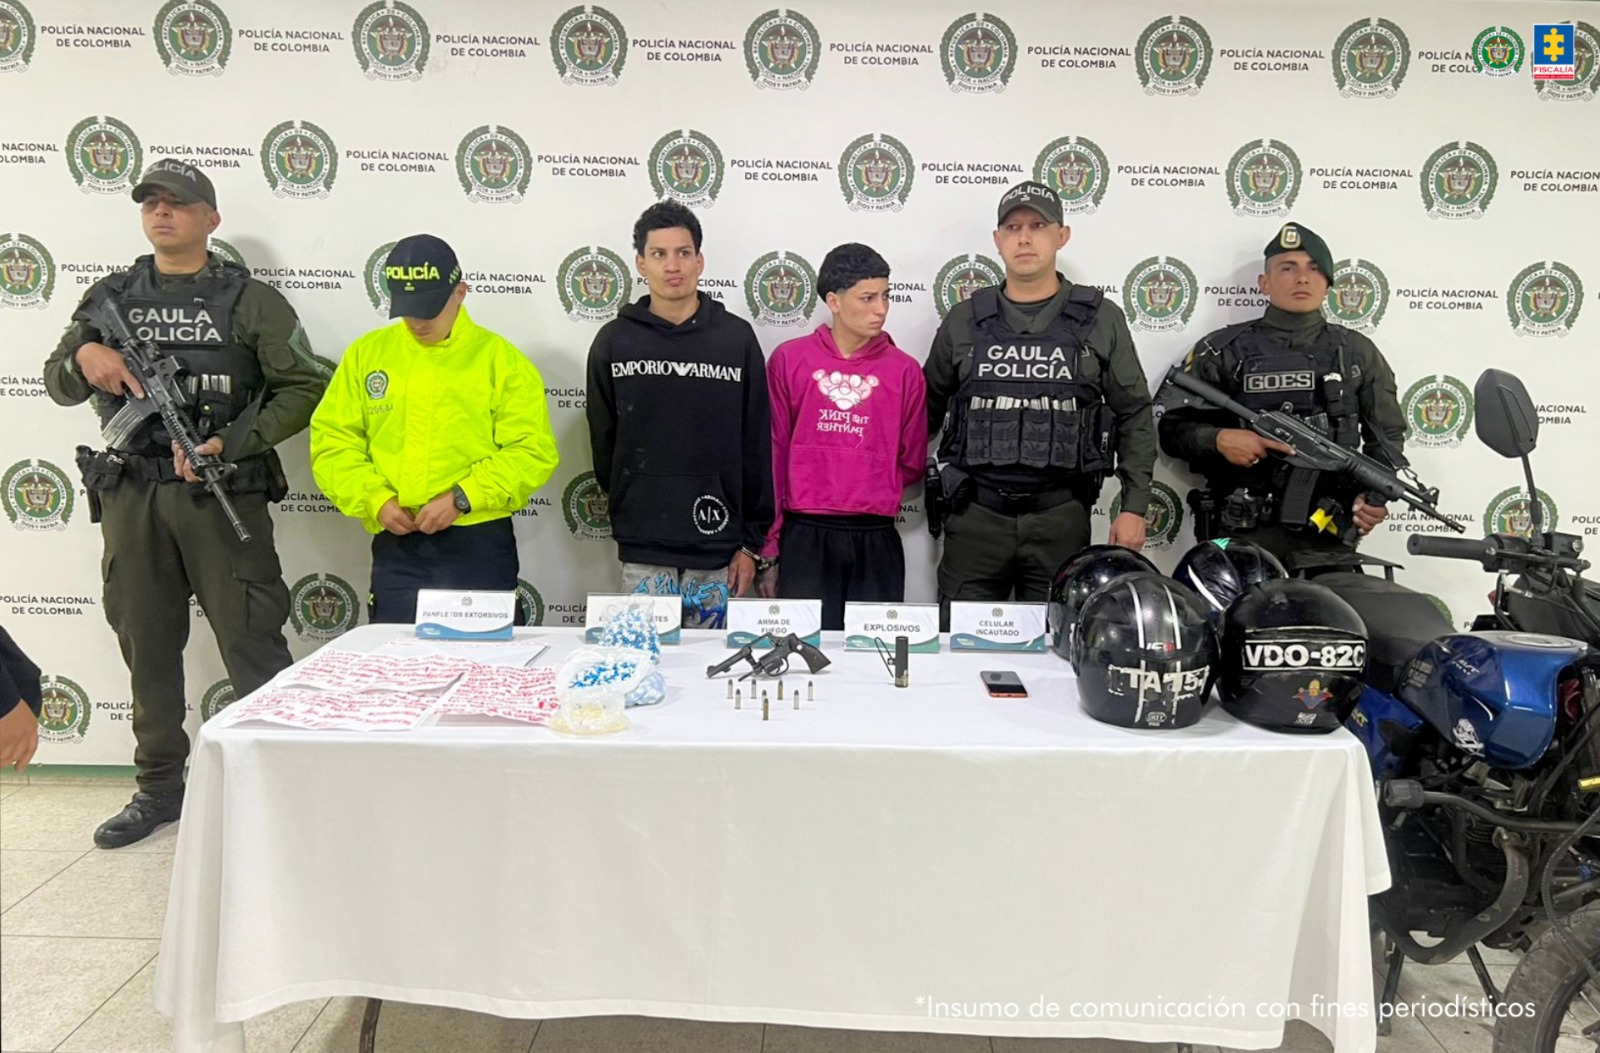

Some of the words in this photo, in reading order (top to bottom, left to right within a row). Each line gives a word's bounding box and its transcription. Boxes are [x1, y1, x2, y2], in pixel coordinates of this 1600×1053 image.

[41, 23, 84, 35] POLICÍA
[87, 26, 145, 36] NACIONAL
[239, 28, 282, 39] POLICÍA
[286, 30, 344, 41] NACIONAL
[56, 38, 70, 48] DE
[73, 38, 131, 48] COLOMBIA
[436, 33, 479, 45] POLICÍA
[483, 35, 540, 46] NACIONAL
[633, 37, 675, 49] POLICÍA
[679, 39, 736, 50] NACIONAL
[254, 42, 268, 52] DE
[271, 42, 329, 53] COLOMBIA
[451, 47, 464, 57] DE
[468, 47, 526, 58] COLOMBIA
[830, 41, 873, 53] POLICÍA
[876, 43, 933, 54] NACIONAL
[1028, 44, 1071, 56] POLICÍA
[1074, 46, 1131, 57] NACIONAL
[1220, 47, 1263, 59] POLICÍA
[1267, 49, 1324, 59] NACIONAL
[647, 51, 661, 61] DE
[664, 52, 721, 62] COLOMBIA
[844, 55, 857, 65] DE
[861, 56, 919, 66] COLOMBIA
[1418, 49, 1462, 61] POLICÍA
[1042, 58, 1055, 68] DE
[1059, 59, 1116, 69] COLOMBIA
[1234, 61, 1248, 71] DE
[1251, 61, 1309, 72] COLOMBIA
[1432, 63, 1446, 73] DE
[2, 142, 59, 152] NACIONAL
[150, 144, 193, 155] POLICÍA
[196, 146, 253, 157] NACIONAL
[0, 154, 46, 164] OLOMBIA
[346, 149, 389, 160] POLICÍA
[392, 151, 449, 161] NACIONAL
[538, 153, 580, 164] POLICÍA
[583, 155, 640, 166] NACIONAL
[361, 162, 374, 172] DE
[378, 163, 435, 173] COLOMBIA
[731, 157, 773, 169] POLICÍA
[776, 160, 832, 170] NACIONAL
[922, 161, 964, 172] POLICÍA
[967, 163, 1023, 173] NACIONAL
[552, 166, 565, 176] DE
[569, 167, 626, 178] COLOMBIA
[1118, 163, 1160, 175] POLICÍA
[1163, 165, 1220, 176] NACIONAL
[1310, 166, 1352, 177] POLICÍA
[1356, 168, 1413, 178] NACIONAL
[1511, 169, 1553, 180] POLICÍA
[1557, 171, 1600, 180] NACION
[745, 171, 758, 181] DE
[762, 172, 818, 182] COLOMBIA
[936, 175, 949, 184] DE
[952, 175, 1009, 185] COLOMBIA
[1131, 177, 1144, 187] DE
[1148, 177, 1205, 187] COLOMBIA
[1323, 180, 1337, 190] DE
[1340, 180, 1397, 190] COLOMBIA
[1524, 182, 1537, 192] DE
[1541, 182, 1598, 193] COLOMBIA
[1001, 186, 1055, 202] POLICÍA
[61, 262, 104, 273] POLICÍA
[253, 267, 295, 277] POLICÍA
[299, 269, 355, 279] NACIONAL
[385, 261, 439, 280] POLICÍA
[76, 275, 89, 285] DE
[460, 272, 486, 282] LICÍA
[490, 273, 546, 283] NACIONAL
[269, 281, 282, 289] DE
[285, 280, 341, 290] COLOMBIA
[698, 279, 738, 288] CIONAL
[887, 283, 926, 292] CIONAL
[476, 284, 532, 295] COLOMBIA
[1205, 284, 1247, 296] POLICÍA
[1397, 287, 1438, 298] POLICÍA
[1442, 289, 1498, 299] NACIONAL
[1218, 297, 1231, 307] DE
[1410, 300, 1423, 310] DE
[1426, 300, 1482, 310] COLOMBIA
[129, 308, 213, 324] GAULA
[135, 323, 222, 342] OLICÍA
[987, 345, 1067, 362] GAULA
[612, 361, 672, 378] EMPORIO
[689, 363, 741, 382] ARMANI
[978, 360, 1072, 380] POLICÍA
[1247, 374, 1312, 391] GOES
[544, 388, 585, 397] POLICÍA
[558, 399, 571, 409] DE
[1538, 416, 1571, 424] OMBIA
[283, 491, 308, 501] LICÍA
[281, 504, 293, 512] DE
[1385, 512, 1416, 521] OLICÍA
[1389, 524, 1400, 532] DE
[1584, 527, 1598, 535] DE
[41, 596, 95, 605] NACIONAL
[12, 606, 25, 615] DE
[28, 606, 82, 616] COLOMBIA
[758, 618, 779, 626] ARMA
[780, 618, 791, 626] DE
[979, 620, 1014, 628] CELULAR
[864, 624, 920, 632] EXPLOSIVOS
[976, 628, 1020, 636] INCAUTADO
[110, 712, 123, 721] DE
